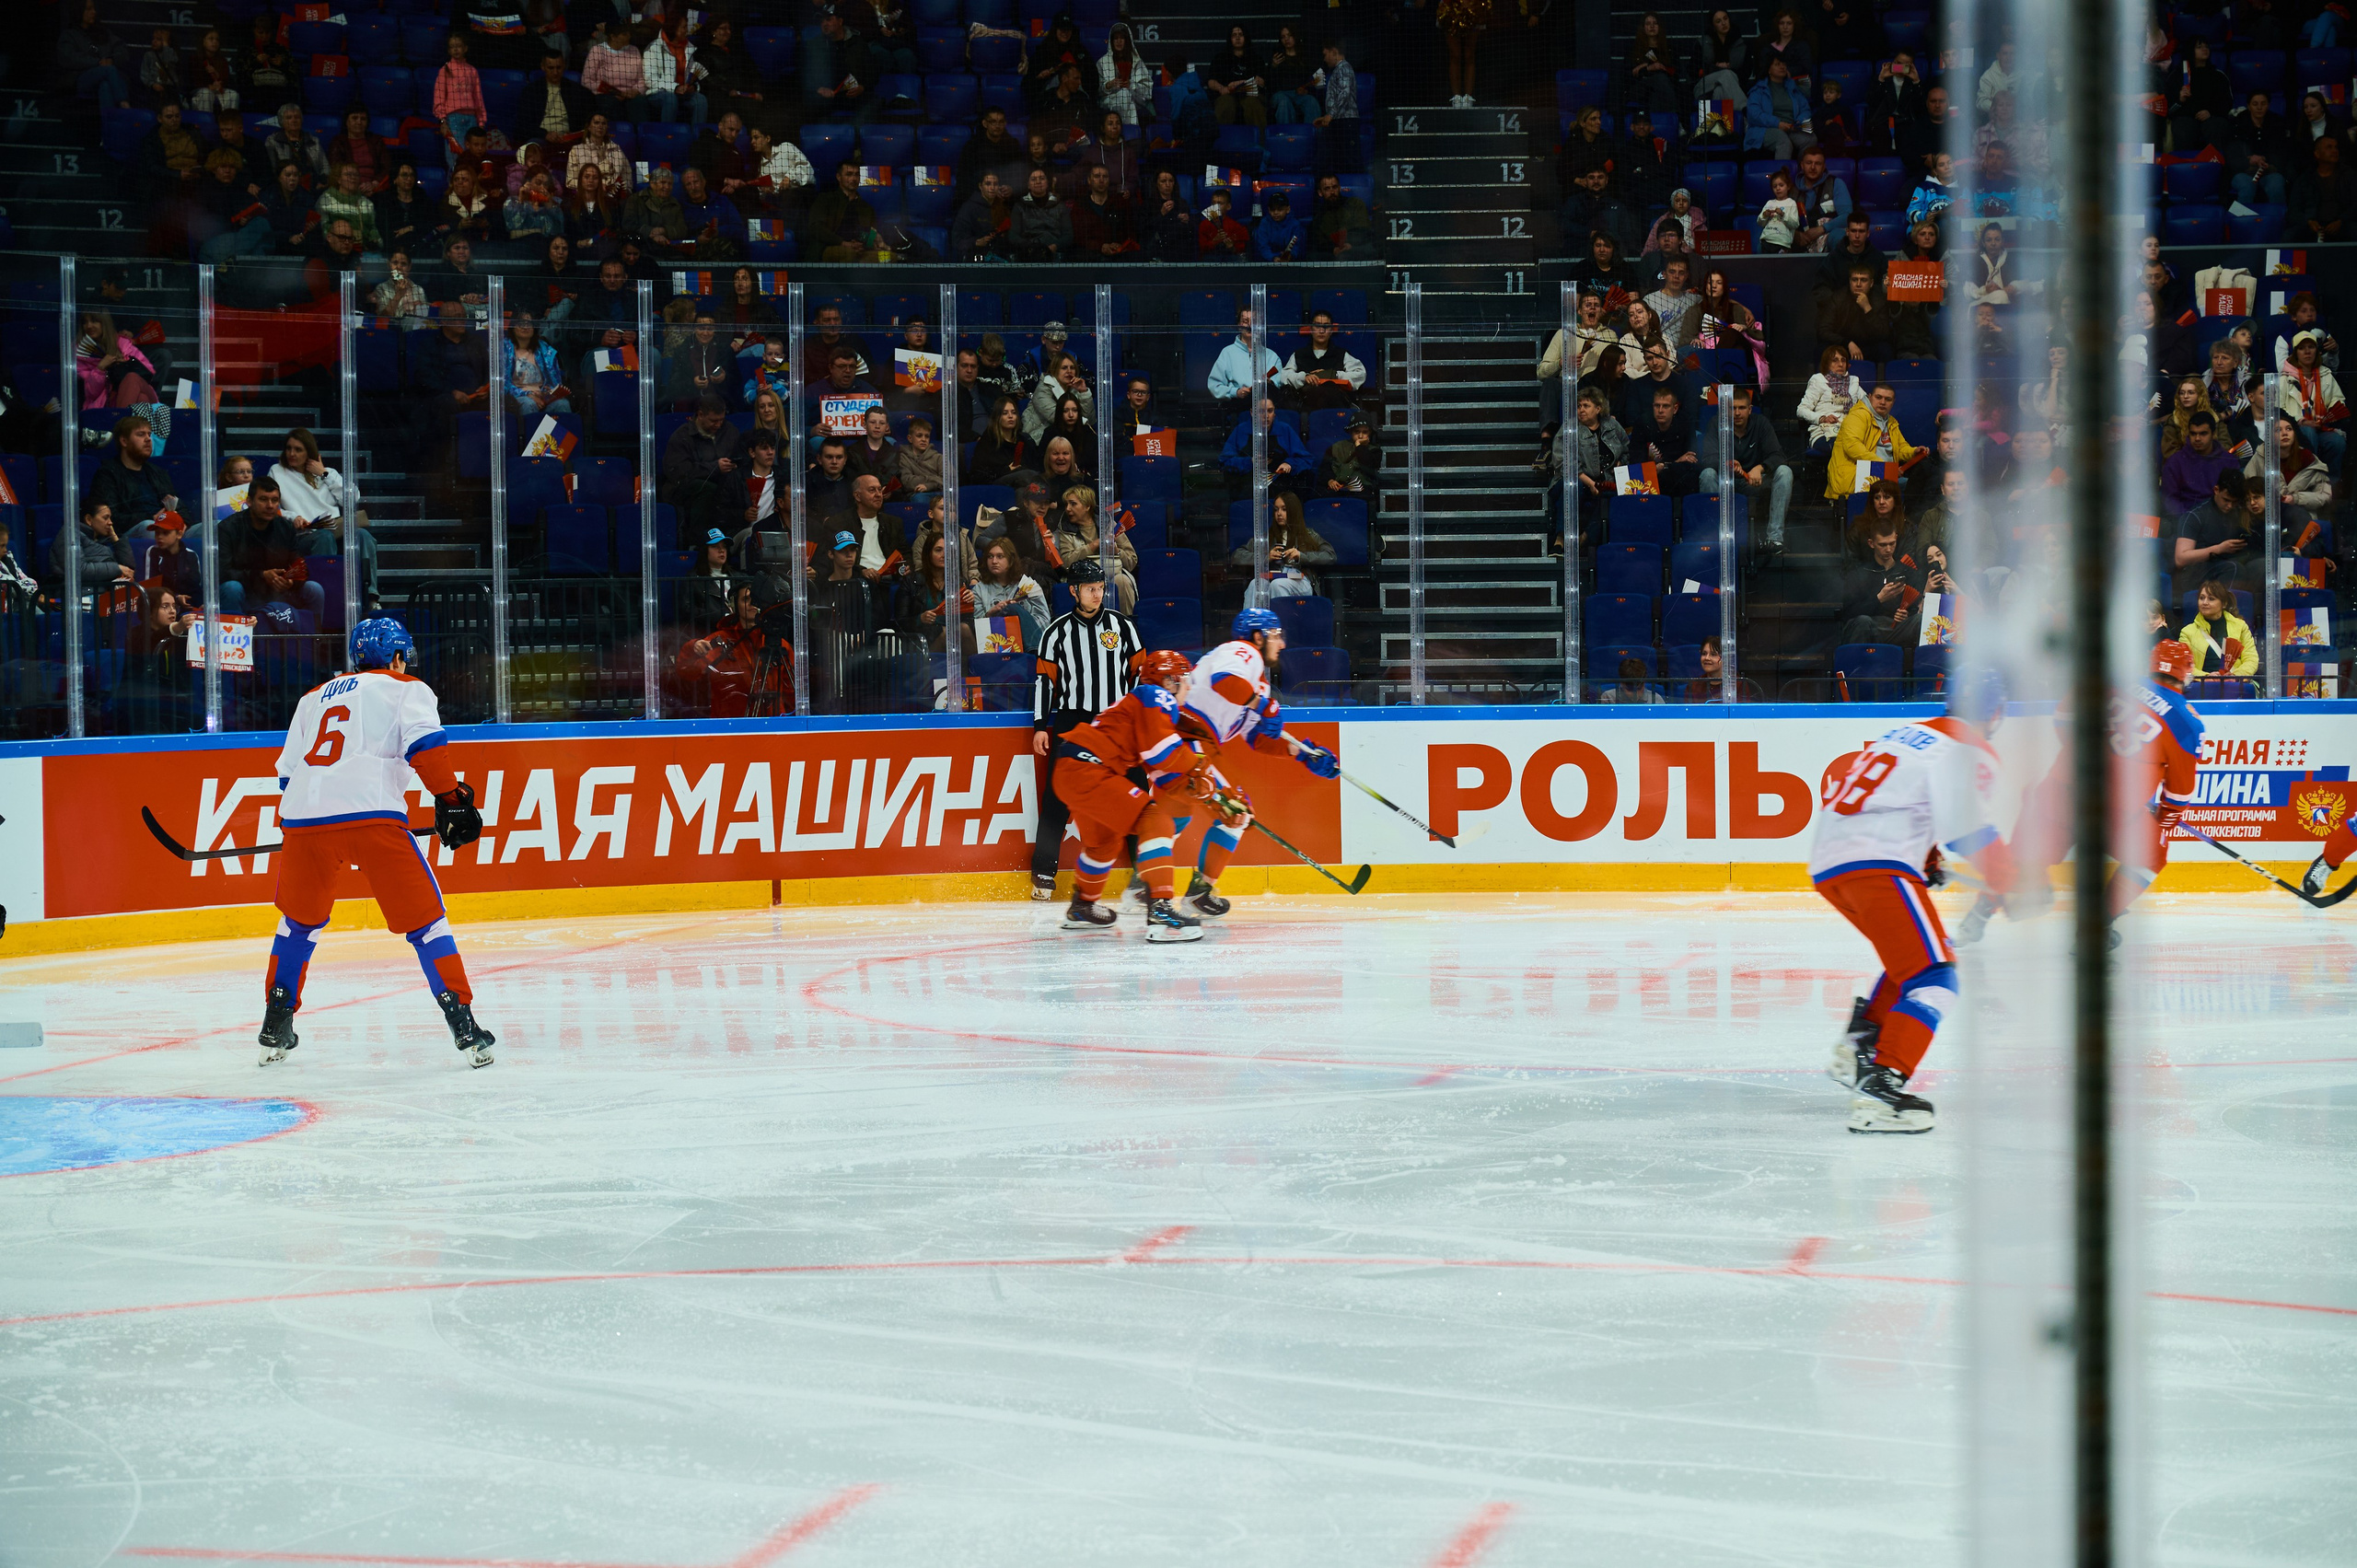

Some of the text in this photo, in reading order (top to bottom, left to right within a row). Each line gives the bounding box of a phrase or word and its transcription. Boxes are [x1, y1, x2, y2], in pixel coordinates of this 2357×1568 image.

[168, 9, 193, 25] 16
[1136, 24, 1159, 41] 16
[15, 99, 39, 119] 14
[1395, 115, 1420, 134] 14
[1497, 113, 1520, 133] 14
[53, 154, 80, 174] 13
[1389, 164, 1415, 183] 13
[1500, 162, 1526, 182] 13
[97, 208, 124, 228] 12
[1388, 218, 1414, 238] 12
[1500, 216, 1526, 238] 12
[143, 268, 163, 288] 11
[1390, 272, 1411, 291] 11
[1504, 271, 1525, 293] 11
[1892, 280, 1922, 288] МАШИНА
[825, 400, 882, 412] СТУДЕН
[1235, 646, 1253, 664] 21
[320, 677, 358, 703] ДИЛЬ
[304, 704, 352, 767] 6
[1077, 751, 1103, 765] CC
[2188, 773, 2271, 805] ШИНА
[655, 754, 1039, 856] МАШИНА
[2217, 809, 2277, 822] ПРОГРАММА
[2201, 826, 2262, 838] ХОККЕИСТОВ
